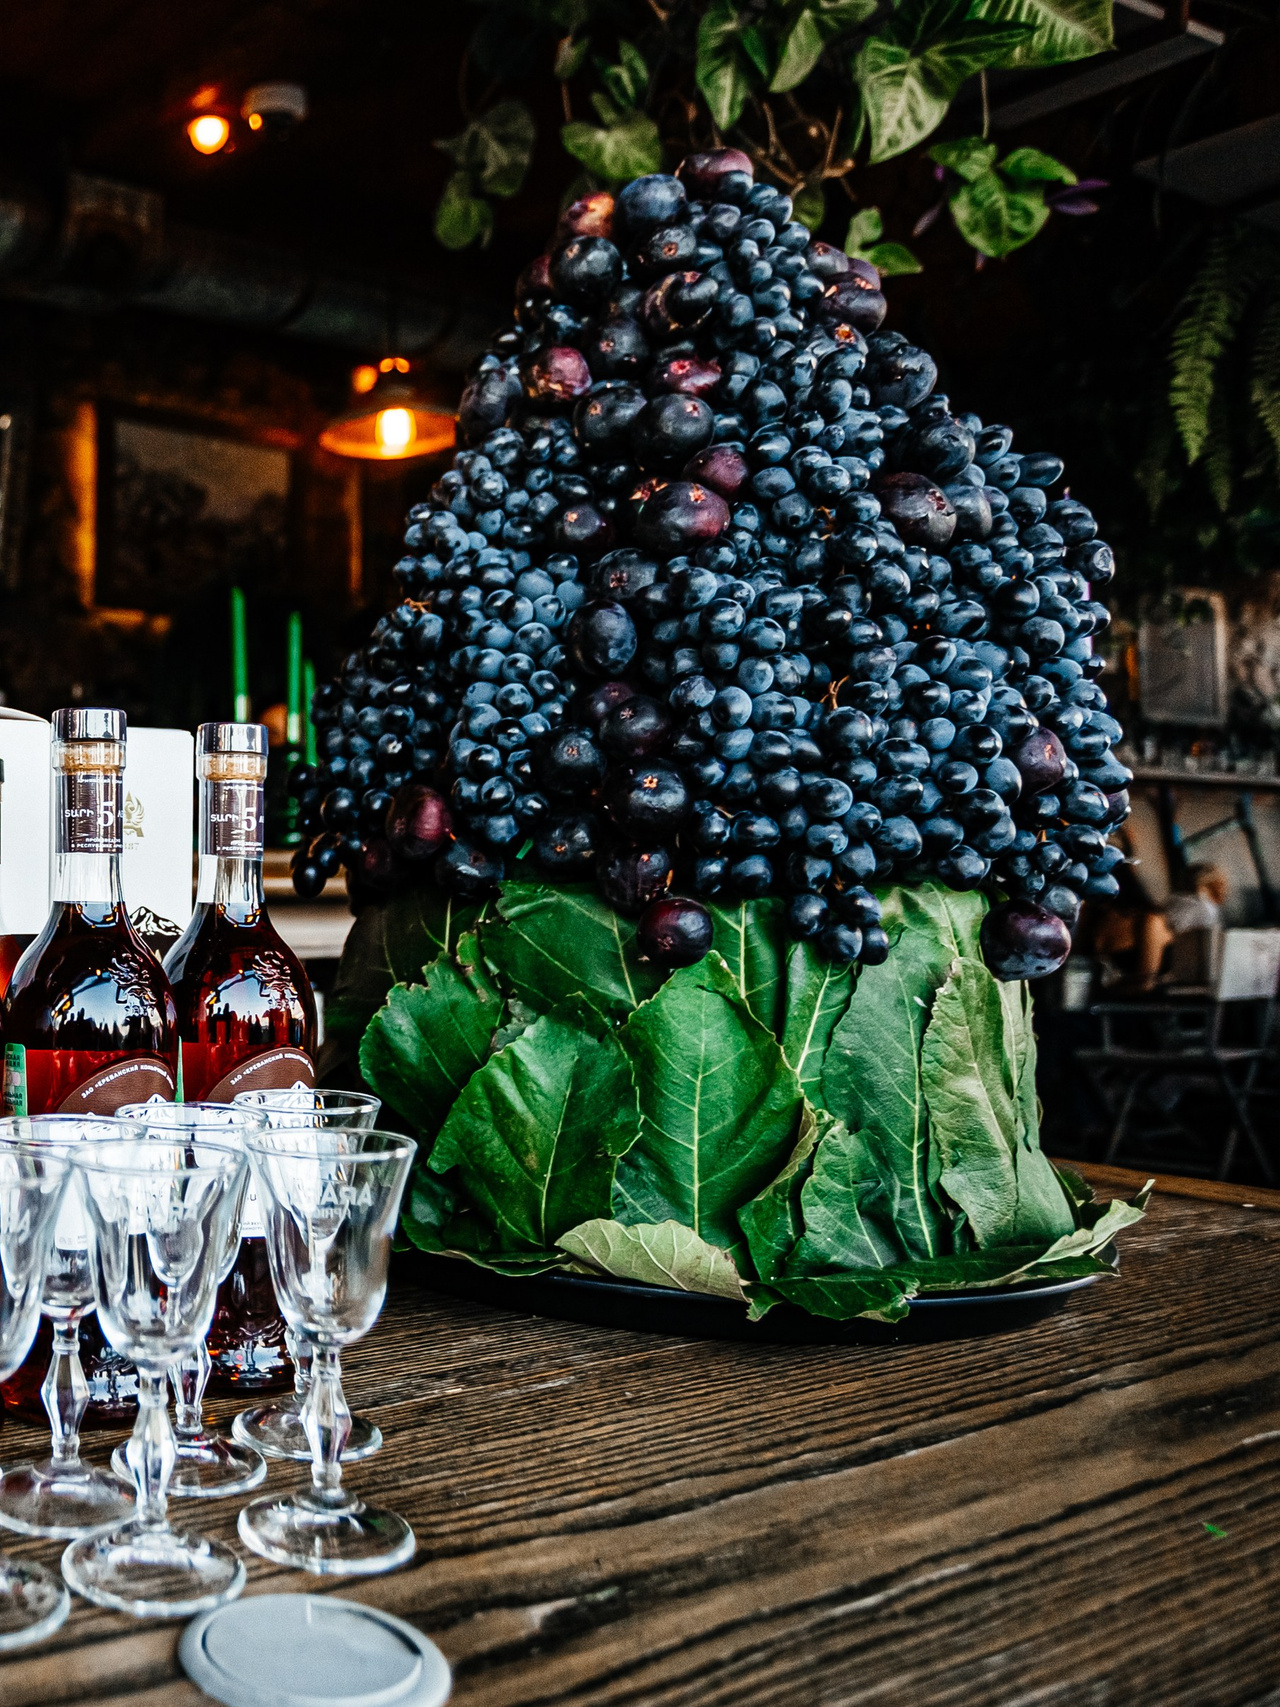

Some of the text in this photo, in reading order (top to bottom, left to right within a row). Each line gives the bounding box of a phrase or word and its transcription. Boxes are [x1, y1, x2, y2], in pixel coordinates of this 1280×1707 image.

[97, 801, 114, 827] 5
[241, 807, 257, 831] 5
[81, 1087, 94, 1099] ЗАО
[95, 1064, 139, 1089] «ЕРЕВАНСКИЙ
